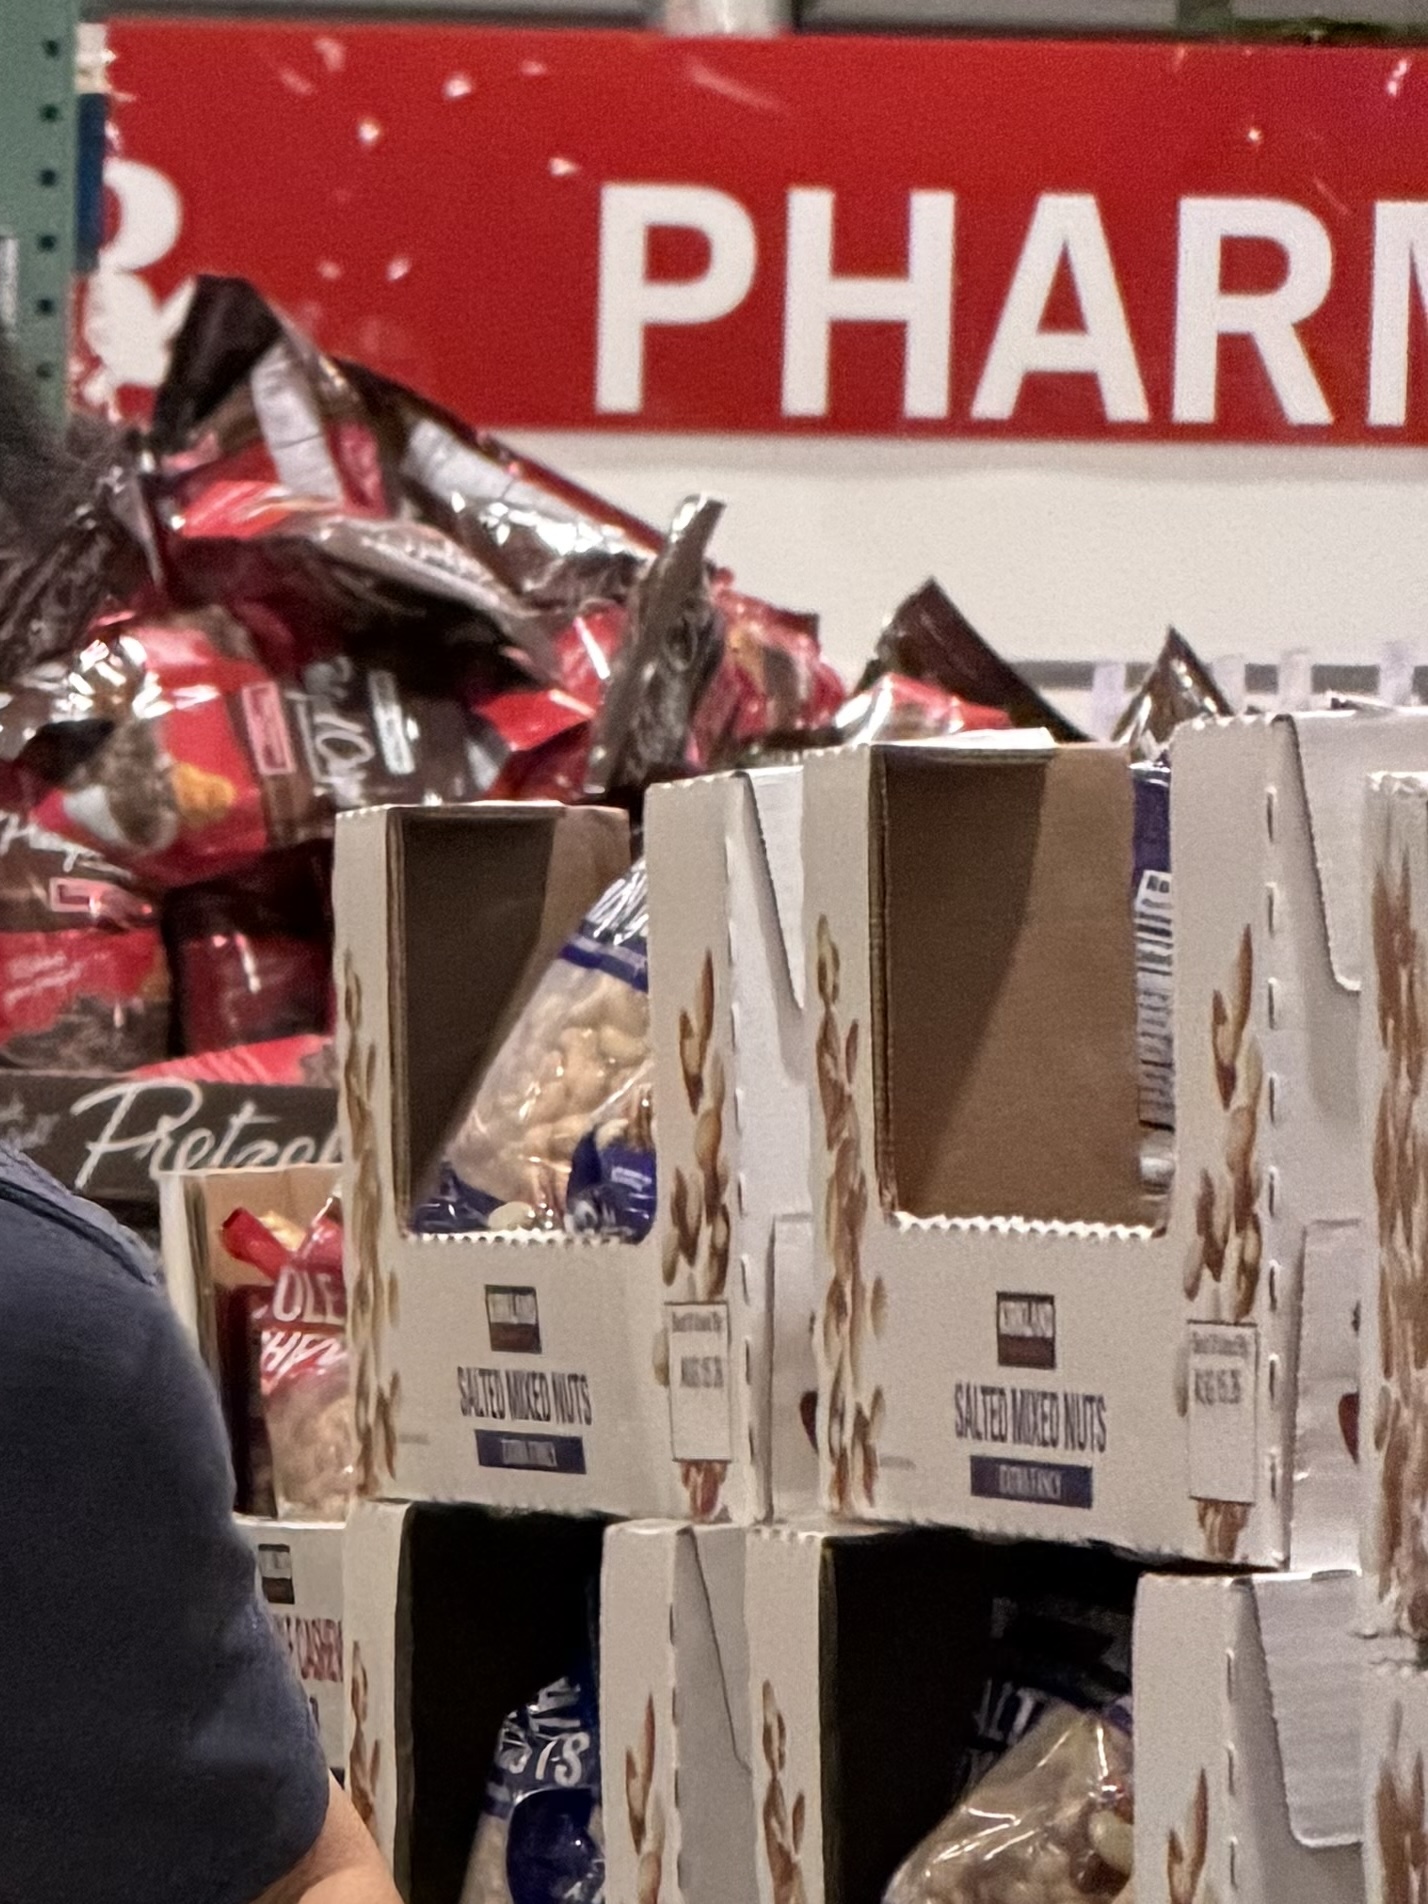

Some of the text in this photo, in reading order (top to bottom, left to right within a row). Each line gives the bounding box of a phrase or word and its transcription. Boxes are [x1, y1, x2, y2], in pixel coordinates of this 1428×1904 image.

[457, 1365, 506, 1421] SALTED
[552, 1371, 594, 1426] NUTS
[953, 1381, 1108, 1453] SALTED MIXED NUTS
